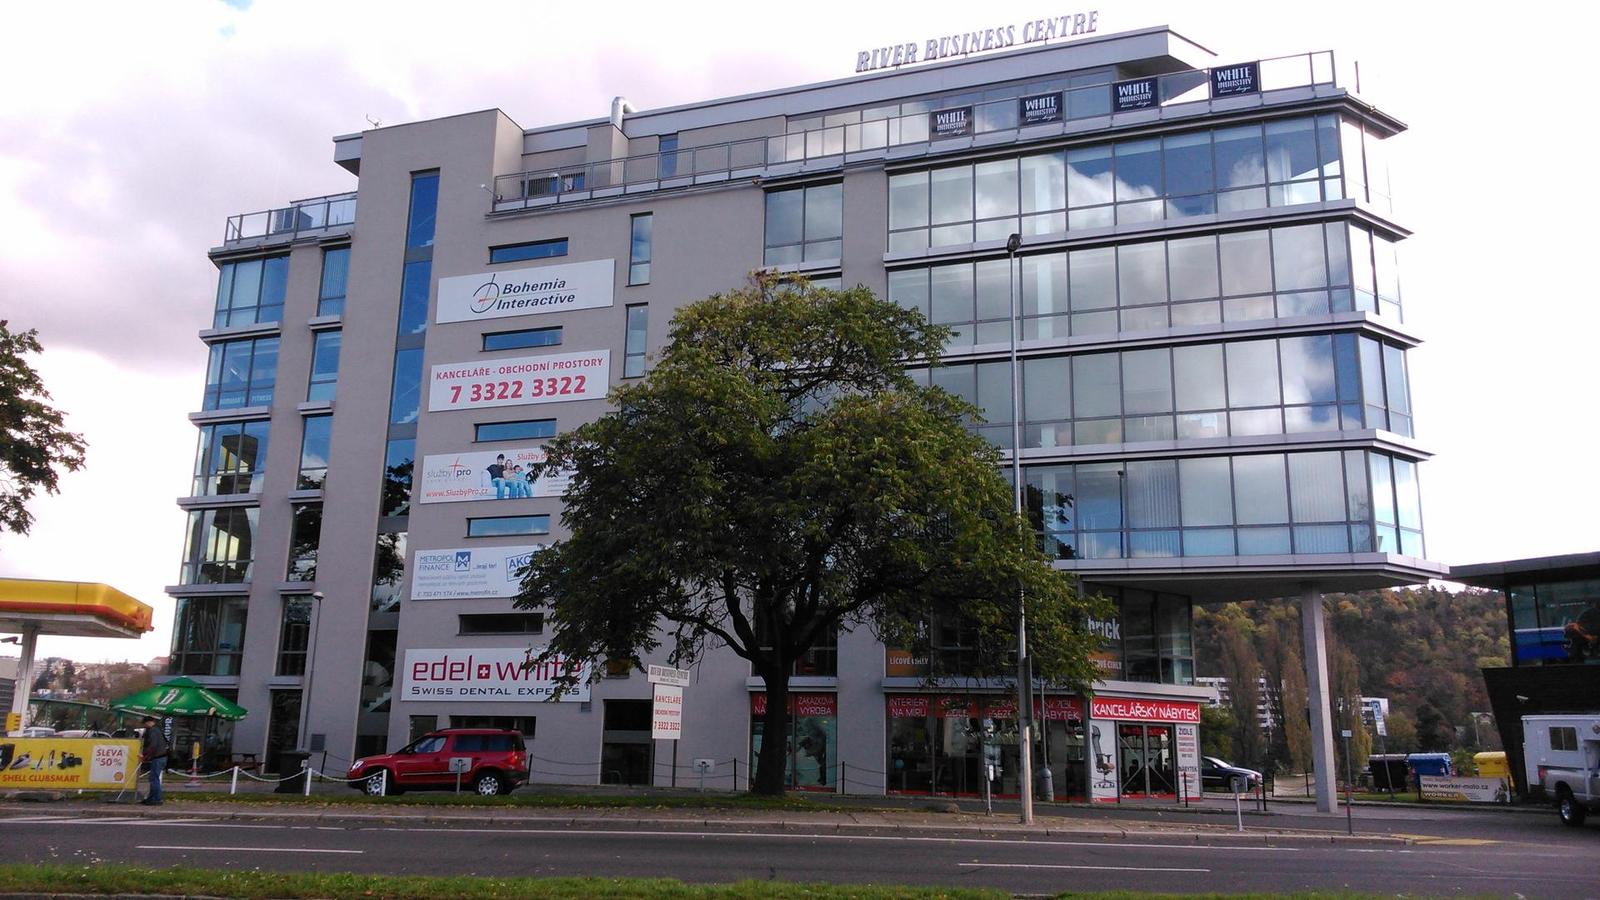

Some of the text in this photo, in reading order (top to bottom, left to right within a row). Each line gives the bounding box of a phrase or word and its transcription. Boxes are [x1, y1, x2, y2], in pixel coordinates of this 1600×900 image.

[856, 10, 1099, 73] RIVER BUSINESS CENTRE
[1217, 66, 1252, 82] WHITE
[1118, 81, 1152, 96] WHITE
[1218, 76, 1252, 89] INDUSTRY
[1026, 97, 1057, 111] WHITE
[1119, 91, 1152, 103] INDUSTRY
[936, 110, 966, 125] WHITE
[1026, 105, 1058, 118] INDUSTRY
[937, 119, 968, 132] INDUSTRY
[502, 278, 566, 296] Bohemia
[497, 293, 575, 310] Interactive
[436, 366, 490, 380] KANCELÁŘE
[498, 361, 550, 375] OBCHODNÍ
[553, 358, 604, 370] PROSTORY
[450, 375, 586, 403] 7 3322 3322
[456, 468, 472, 478] pro
[419, 563, 450, 571] FINANCE
[412, 655, 473, 681] edel
[459, 687, 512, 695] DENTAL
[1093, 702, 1157, 718] KANCELÁŘSKÝ
[1159, 704, 1198, 720] NÁBYTEK
[96, 749, 123, 757] SLEVA
[3, 774, 80, 783] SHELL CLUBSMART
